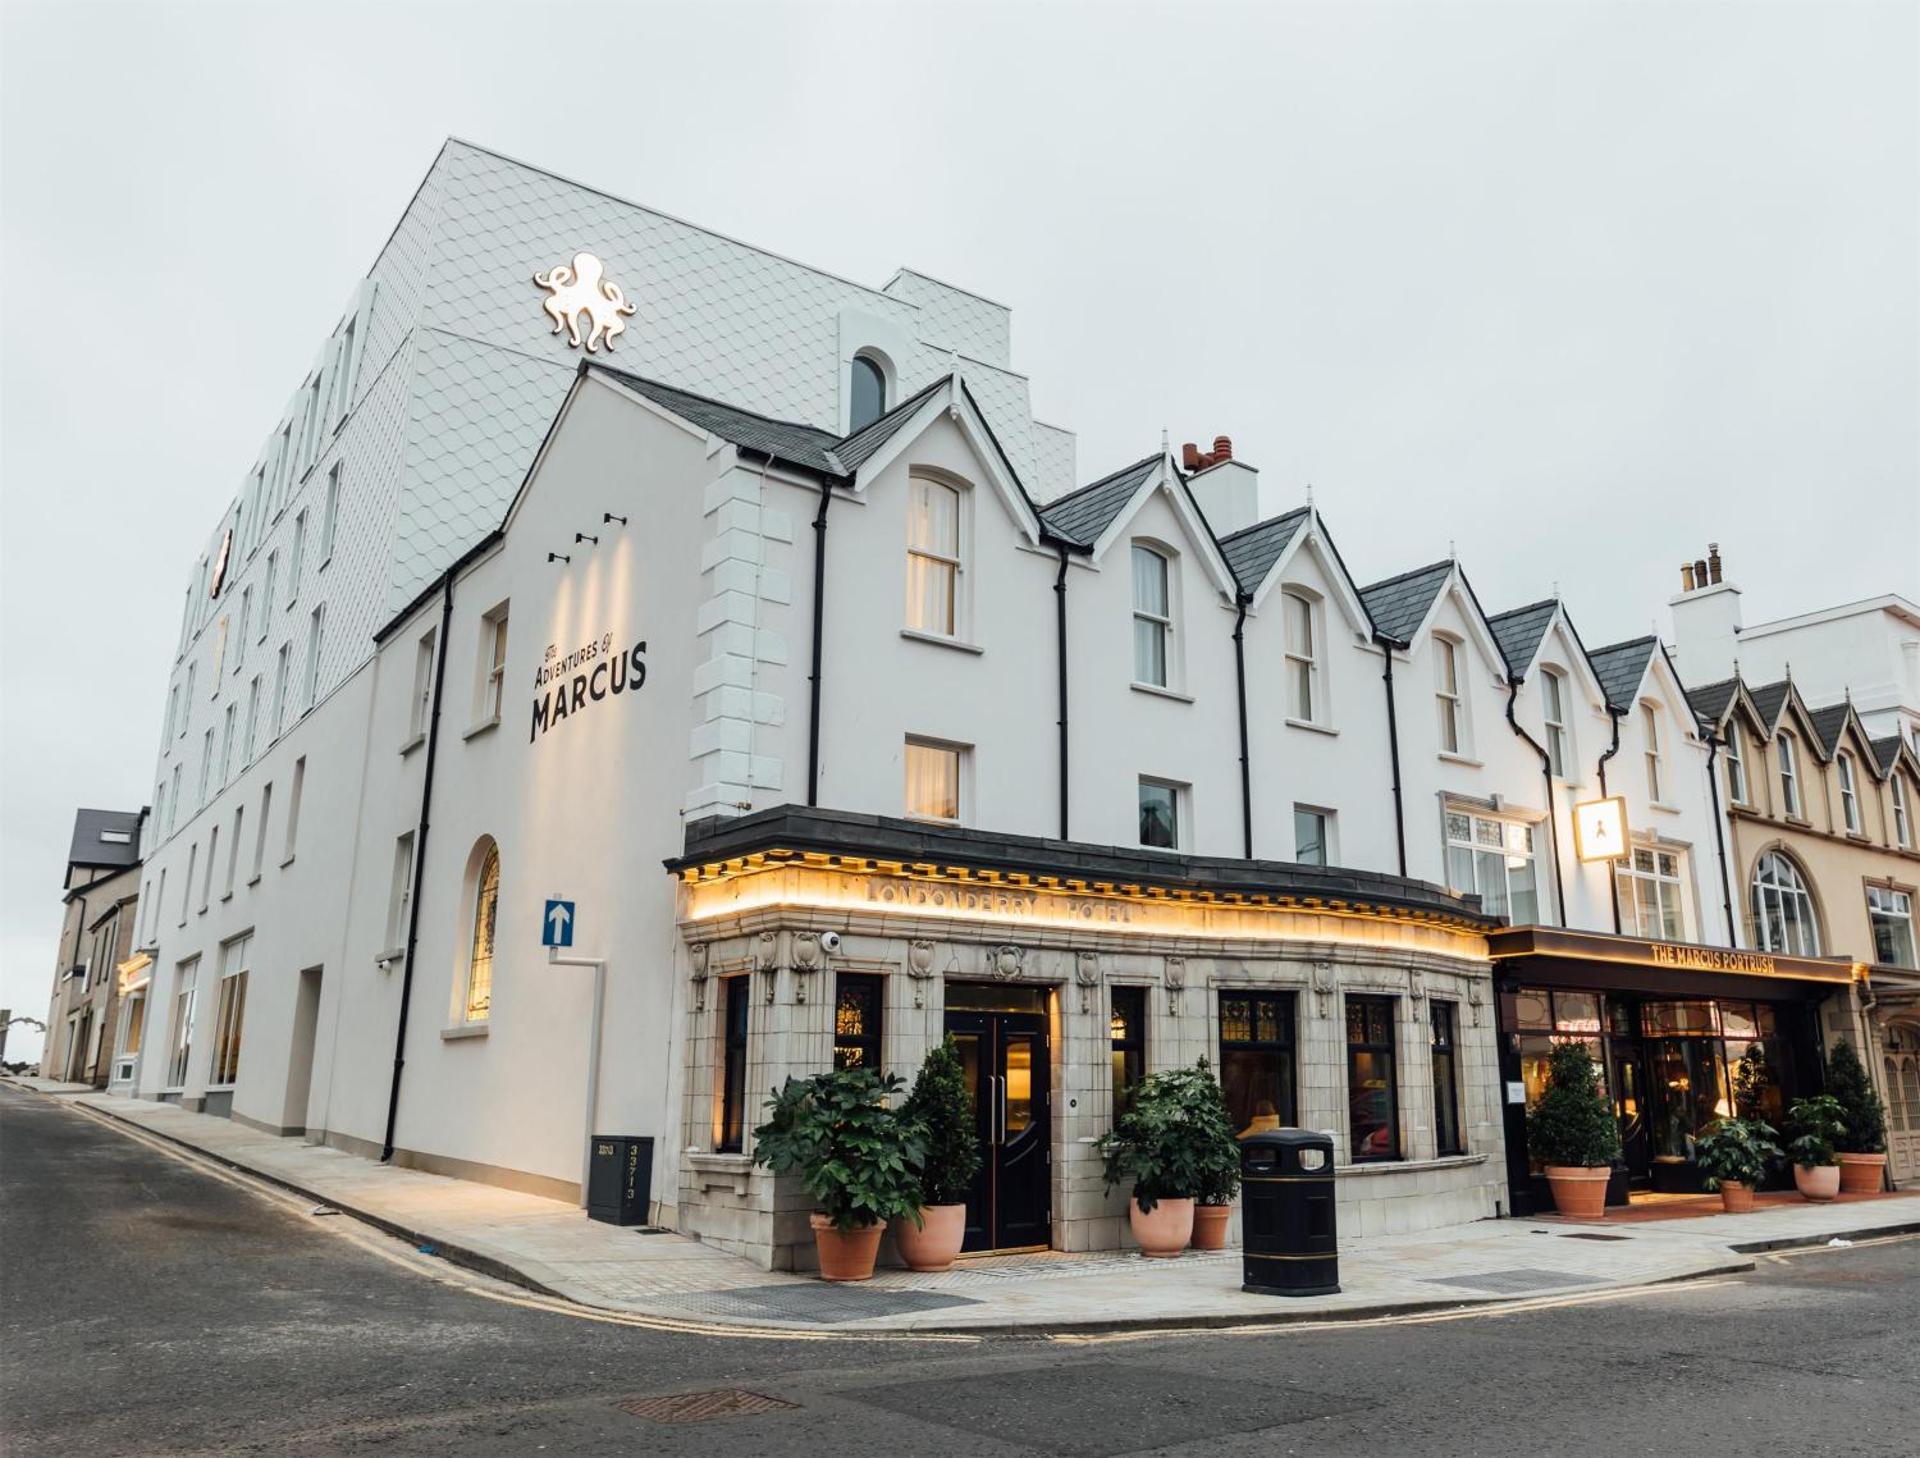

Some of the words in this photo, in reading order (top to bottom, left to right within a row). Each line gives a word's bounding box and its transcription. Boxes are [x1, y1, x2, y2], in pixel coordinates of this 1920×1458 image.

[530, 640, 647, 744] MARCUS
[866, 883, 1039, 918] LONDONDERRY
[1067, 901, 1131, 924] HOTEL
[1652, 945, 1675, 963] THE
[1676, 947, 1722, 968] MARCUS
[1723, 953, 1776, 974] PORTRUSH
[627, 1145, 639, 1199] 33713
